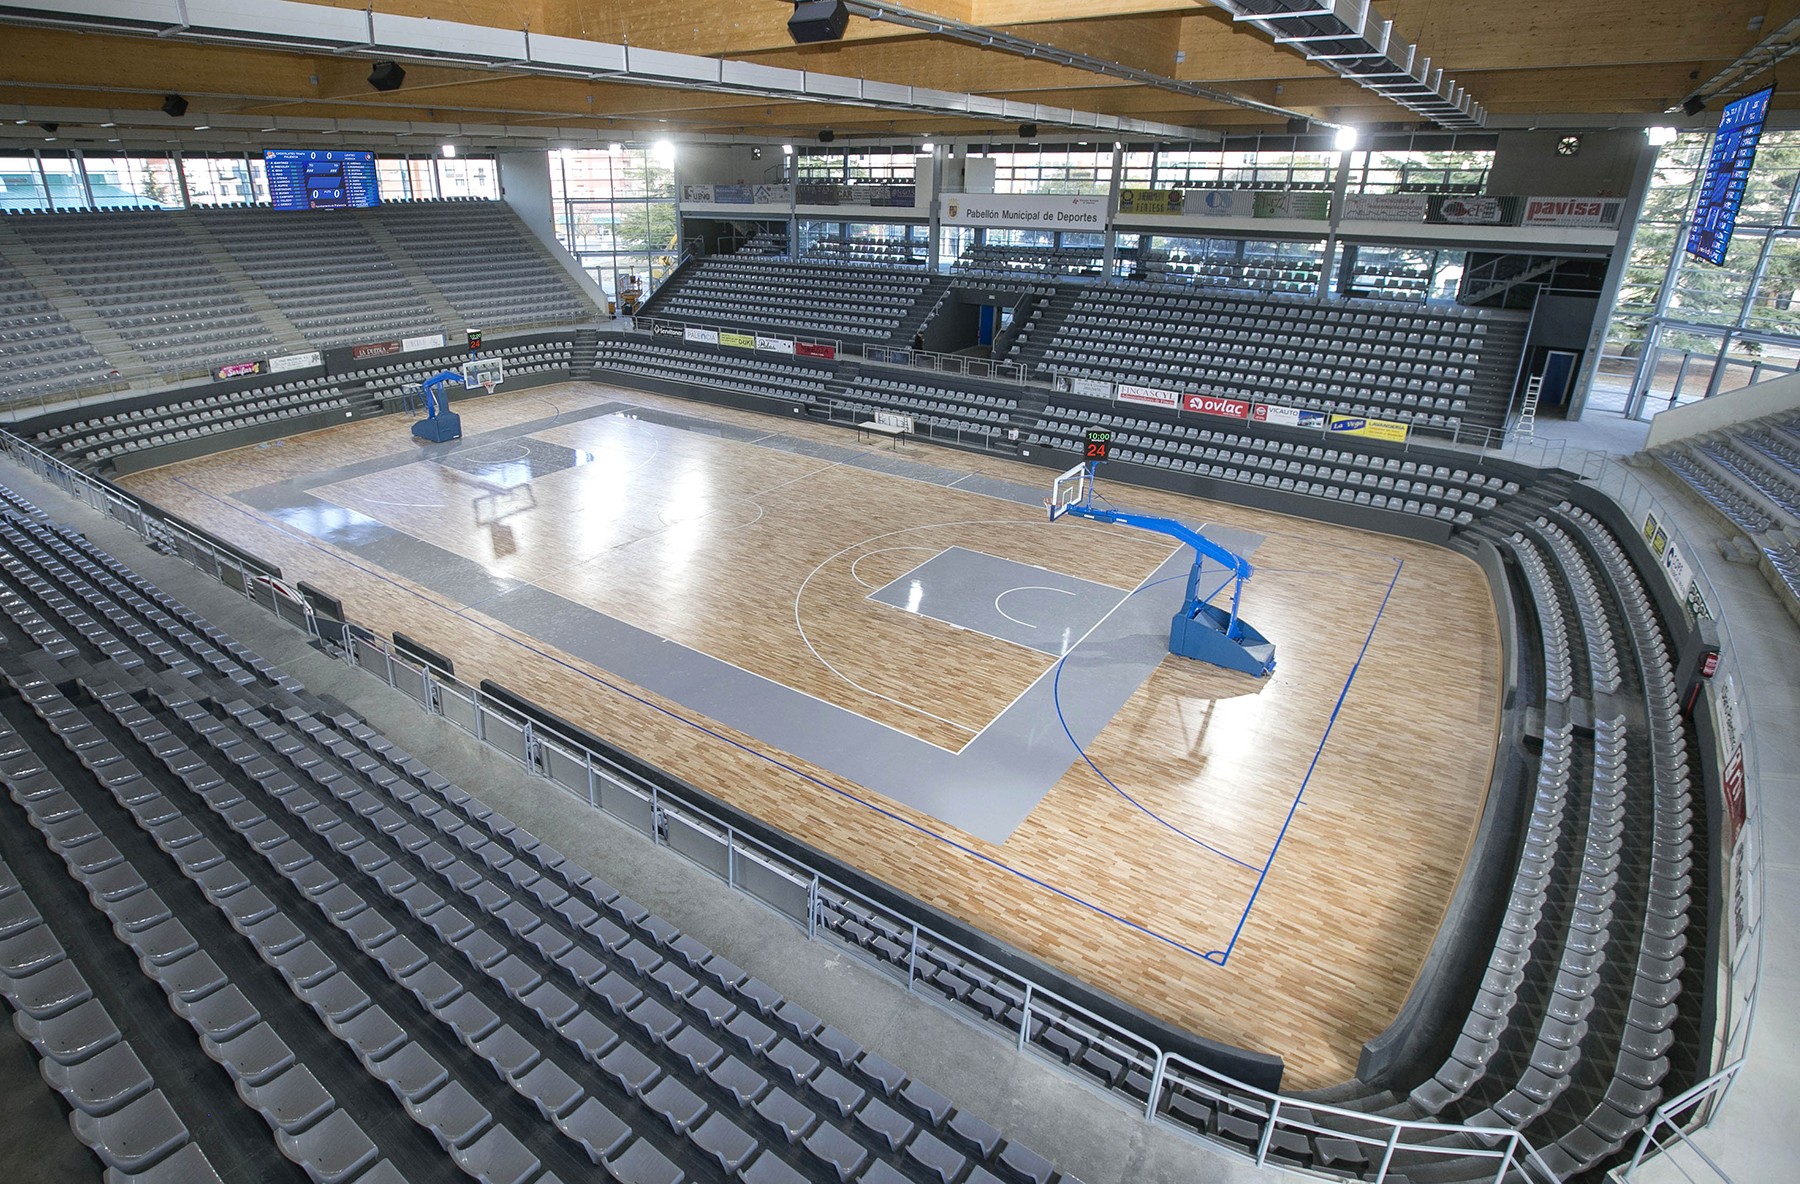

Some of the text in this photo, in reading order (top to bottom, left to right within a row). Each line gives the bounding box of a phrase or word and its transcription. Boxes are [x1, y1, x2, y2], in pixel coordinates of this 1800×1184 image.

[966, 208, 1098, 223] Pabellón Municipal de Deportes
[1527, 199, 1601, 221] pavisa
[687, 331, 716, 341] PALENCIA
[470, 340, 480, 349] 24
[1121, 386, 1175, 399] FINCASCYL
[1204, 400, 1243, 414] ovlac
[1269, 407, 1299, 416] VICAUTO
[1088, 432, 1110, 440] 10:00
[1087, 443, 1105, 456] 24
